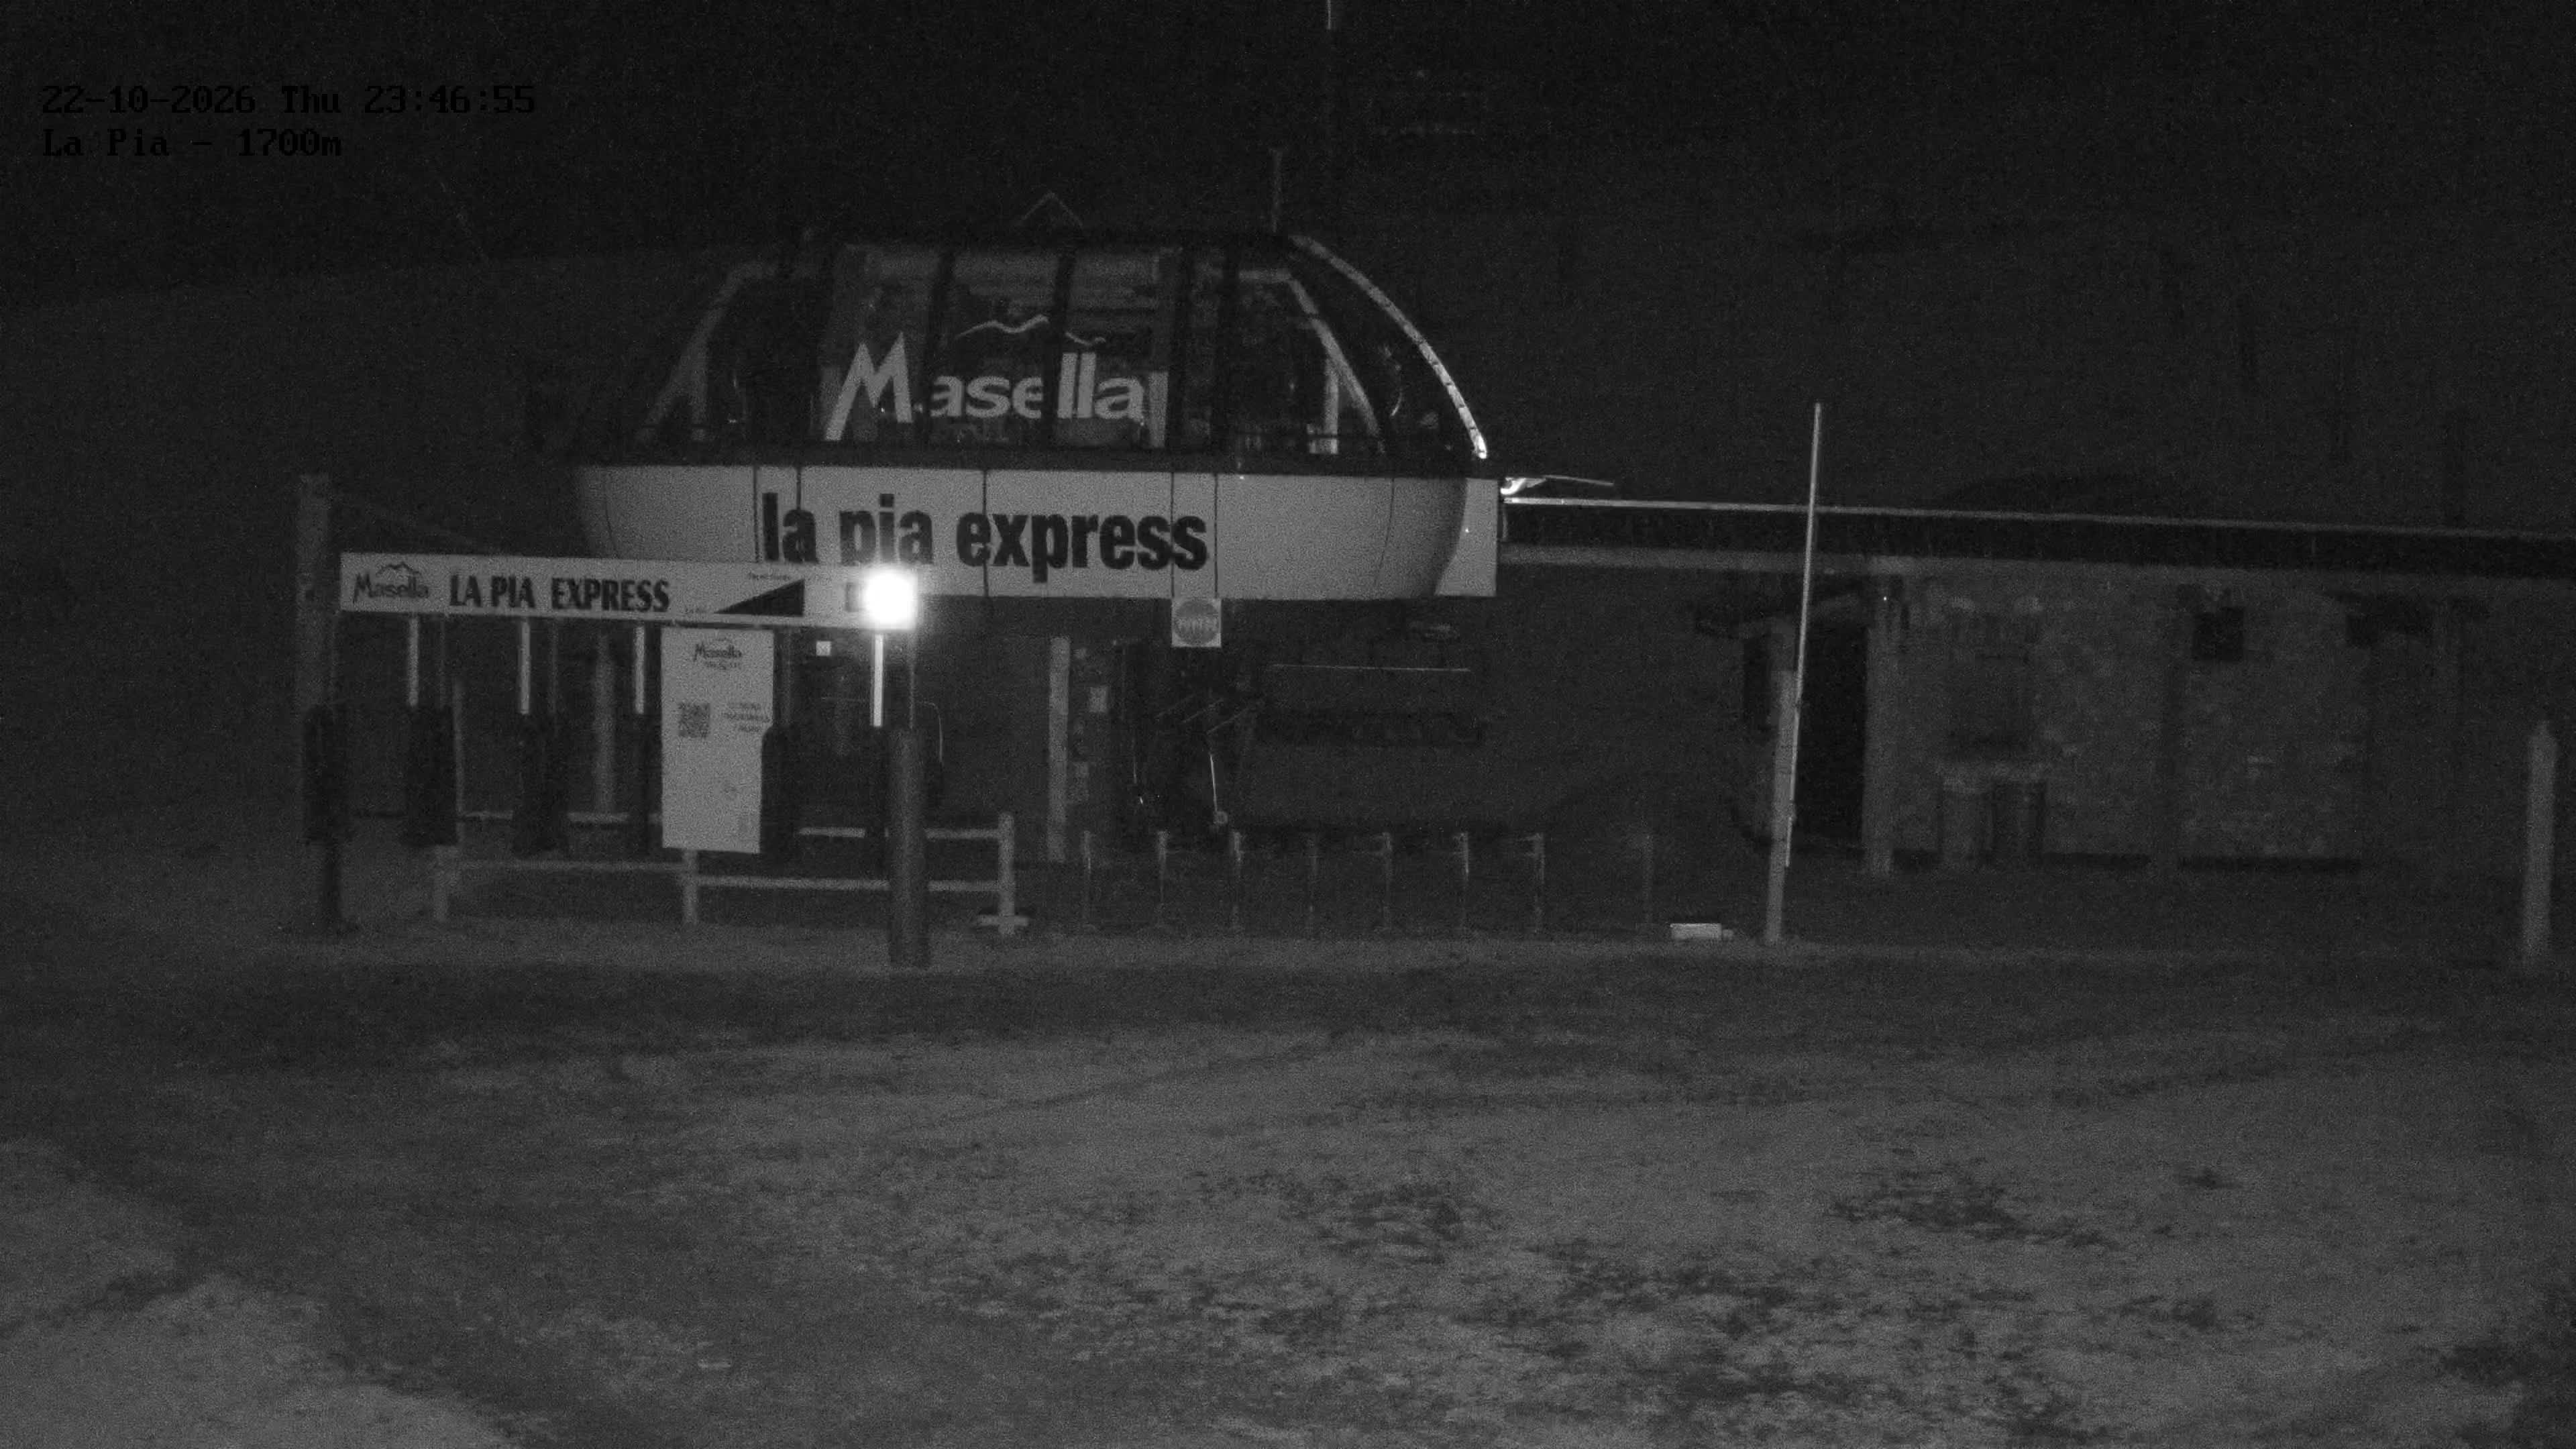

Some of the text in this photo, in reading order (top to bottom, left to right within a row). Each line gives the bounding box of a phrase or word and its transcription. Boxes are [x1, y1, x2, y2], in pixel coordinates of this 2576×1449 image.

[825, 332, 1144, 441] Masella
[762, 492, 1208, 584] la pia express
[352, 570, 429, 604] Masella
[449, 574, 671, 613] LA PIA EXPRESS
